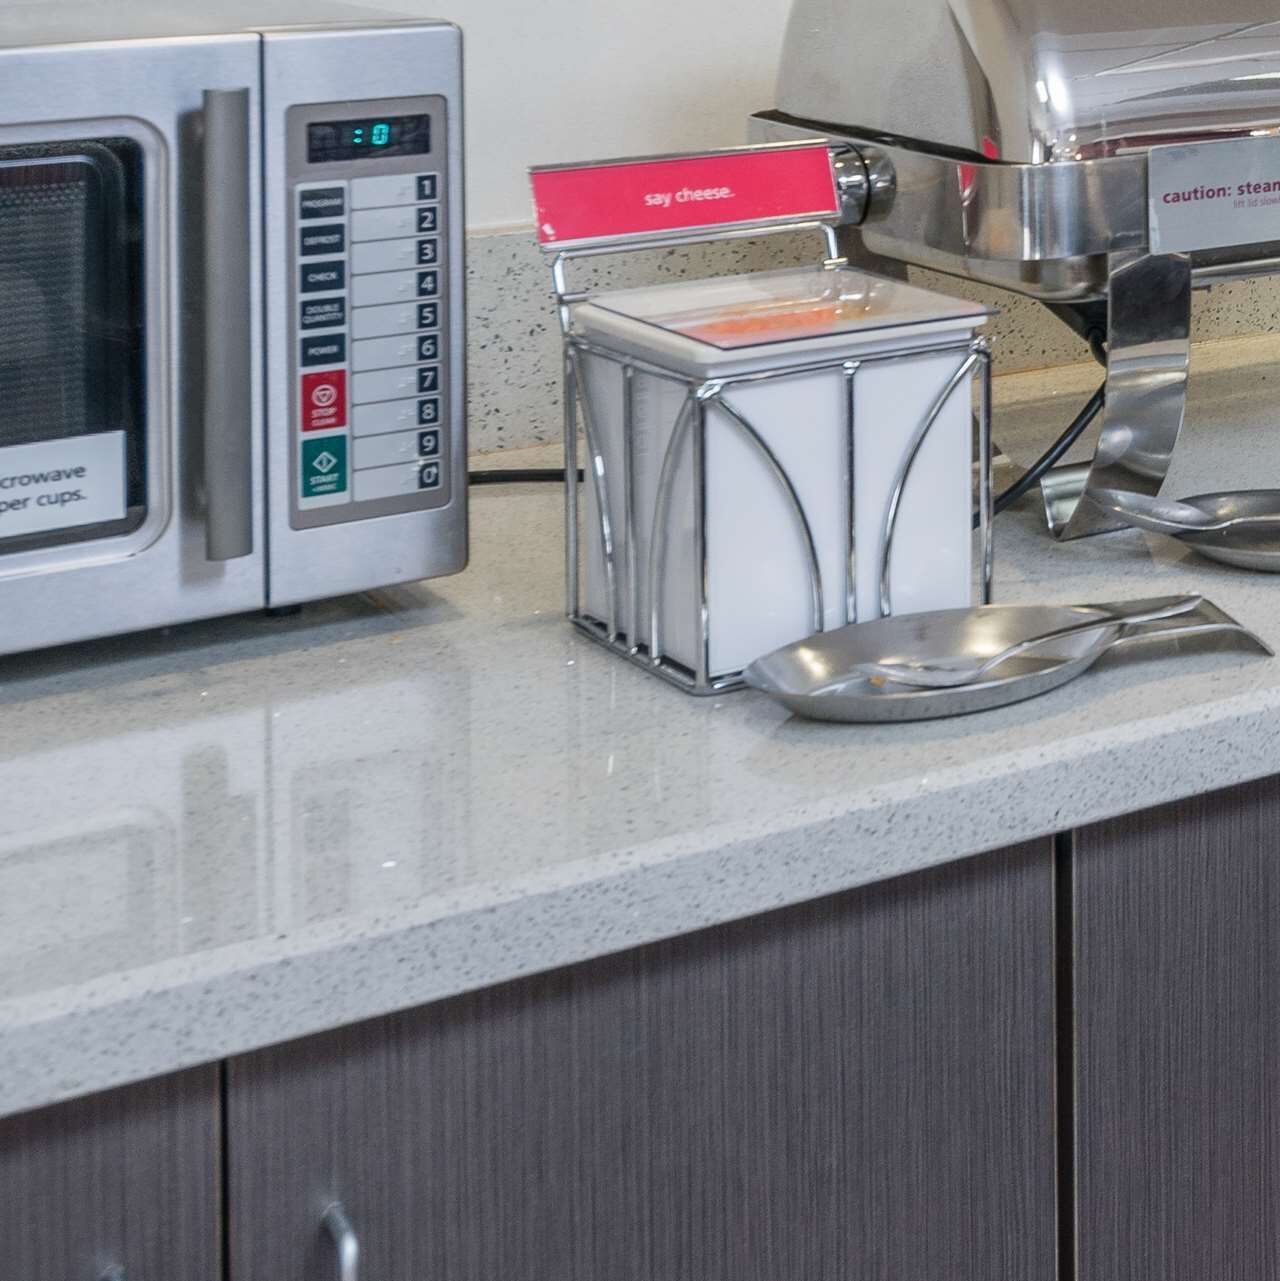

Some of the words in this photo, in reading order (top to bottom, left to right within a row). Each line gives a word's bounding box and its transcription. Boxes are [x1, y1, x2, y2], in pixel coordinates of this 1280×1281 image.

[421, 179, 432, 195] 1
[1162, 185, 1232, 204] caution:
[644, 192, 672, 208] say
[675, 187, 736, 202] cheese.
[421, 211, 434, 228] 2
[421, 243, 434, 260] 3
[421, 275, 434, 291] 4
[421, 307, 434, 324] 5
[421, 339, 434, 355] 6
[421, 371, 434, 388] 7
[421, 403, 434, 420] 8
[422, 435, 435, 452] 9
[422, 466, 436, 484] 0
[36, 489, 88, 508] cups.
